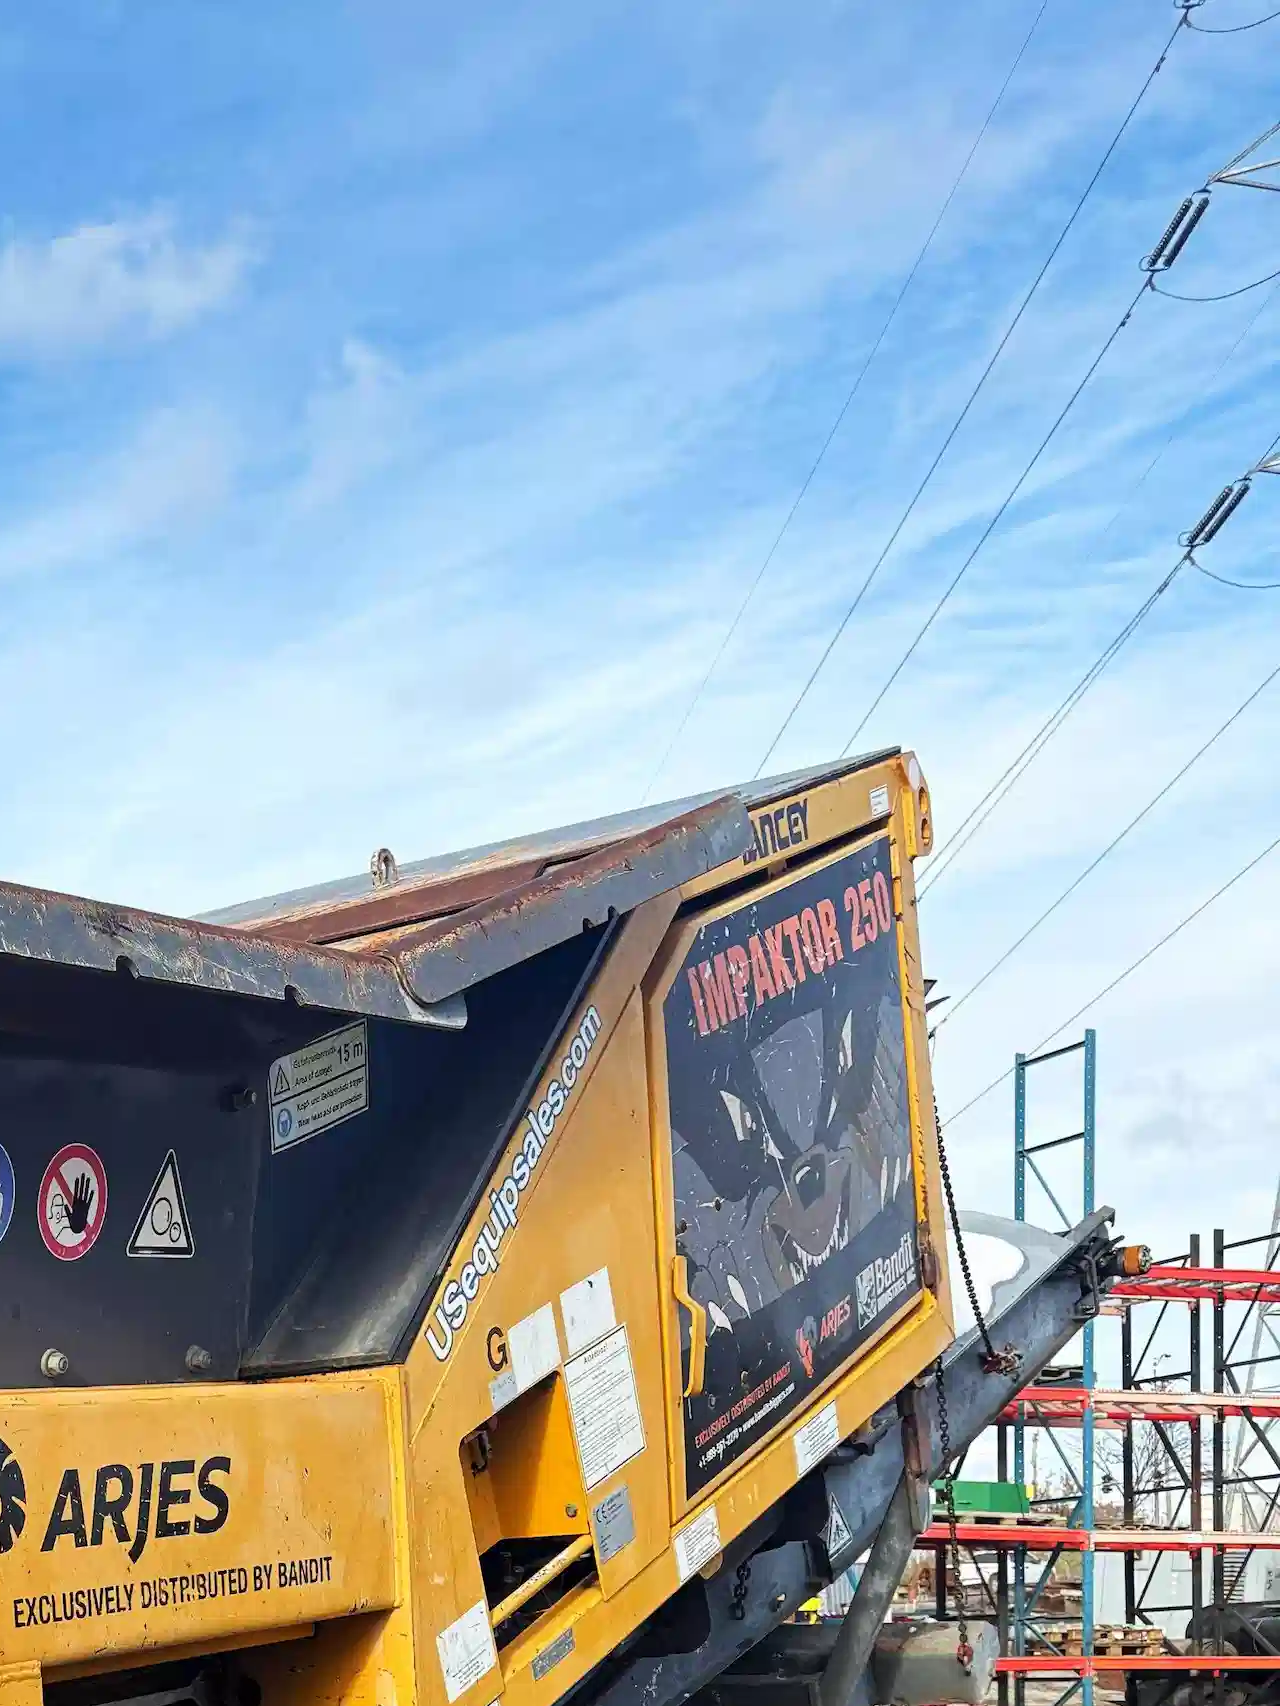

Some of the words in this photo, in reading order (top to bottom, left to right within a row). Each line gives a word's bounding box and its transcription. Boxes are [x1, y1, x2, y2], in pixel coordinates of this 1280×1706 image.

[687, 899, 844, 1036] IMPAKTOR
[844, 871, 891, 952] 250
[337, 1043, 350, 1064] 15
[353, 1042, 363, 1059] m
[424, 1004, 603, 1362] USequipsales.com
[874, 1231, 914, 1296] Bandit
[487, 1326, 508, 1371] G
[820, 1294, 851, 1343] ARJES
[694, 1410, 730, 1448] EXCLUSIVELY
[731, 1383, 766, 1420] DISTRIBUTED
[764, 1376, 773, 1392] BY
[772, 1361, 790, 1386] BANDIT
[40, 1456, 232, 1564] ARJES
[13, 1583, 135, 1628] EXCLUSIVELY
[140, 1567, 248, 1609] DISTRIBUTED
[253, 1564, 273, 1590] BY
[278, 1556, 333, 1588] BANDIT
